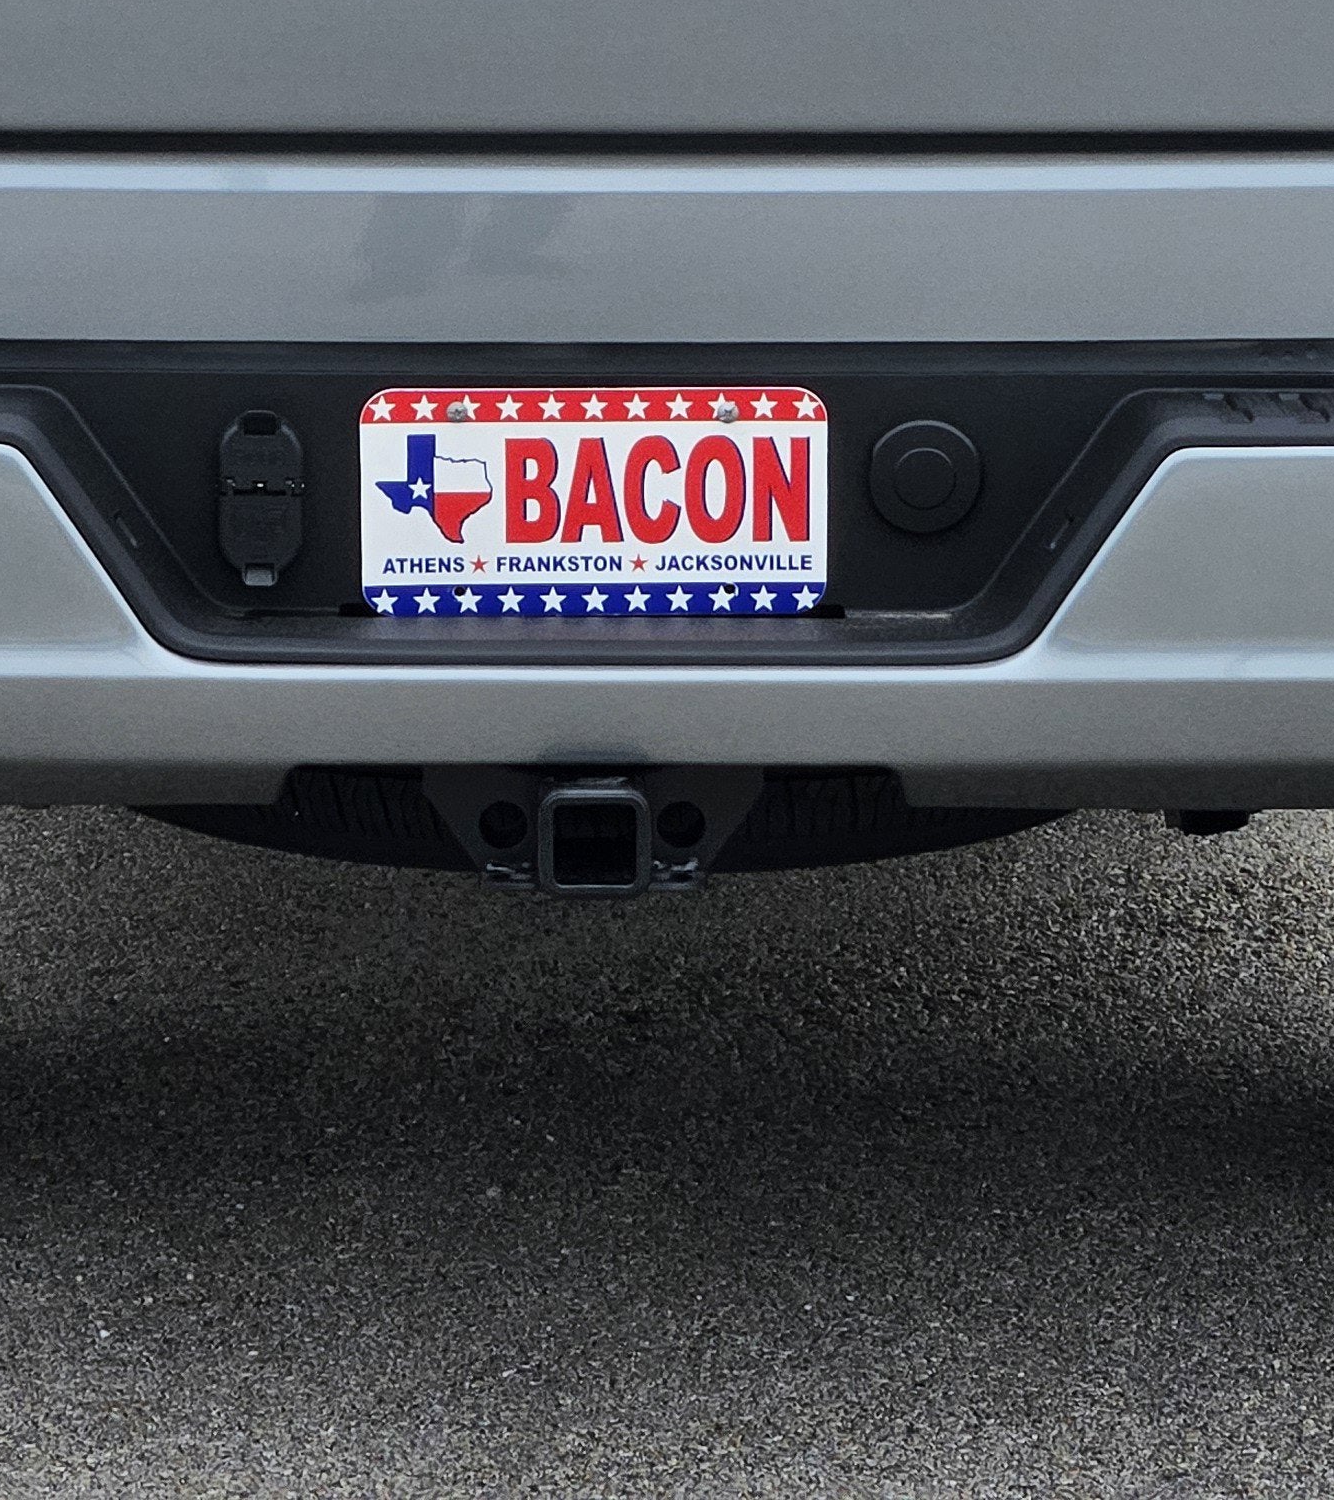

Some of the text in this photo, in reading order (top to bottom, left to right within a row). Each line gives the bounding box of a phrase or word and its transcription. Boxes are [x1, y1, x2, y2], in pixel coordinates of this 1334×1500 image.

[504, 435, 811, 544] BACON
[382, 553, 813, 575] ATHENS FRANKSTON JACKSONVILLE
